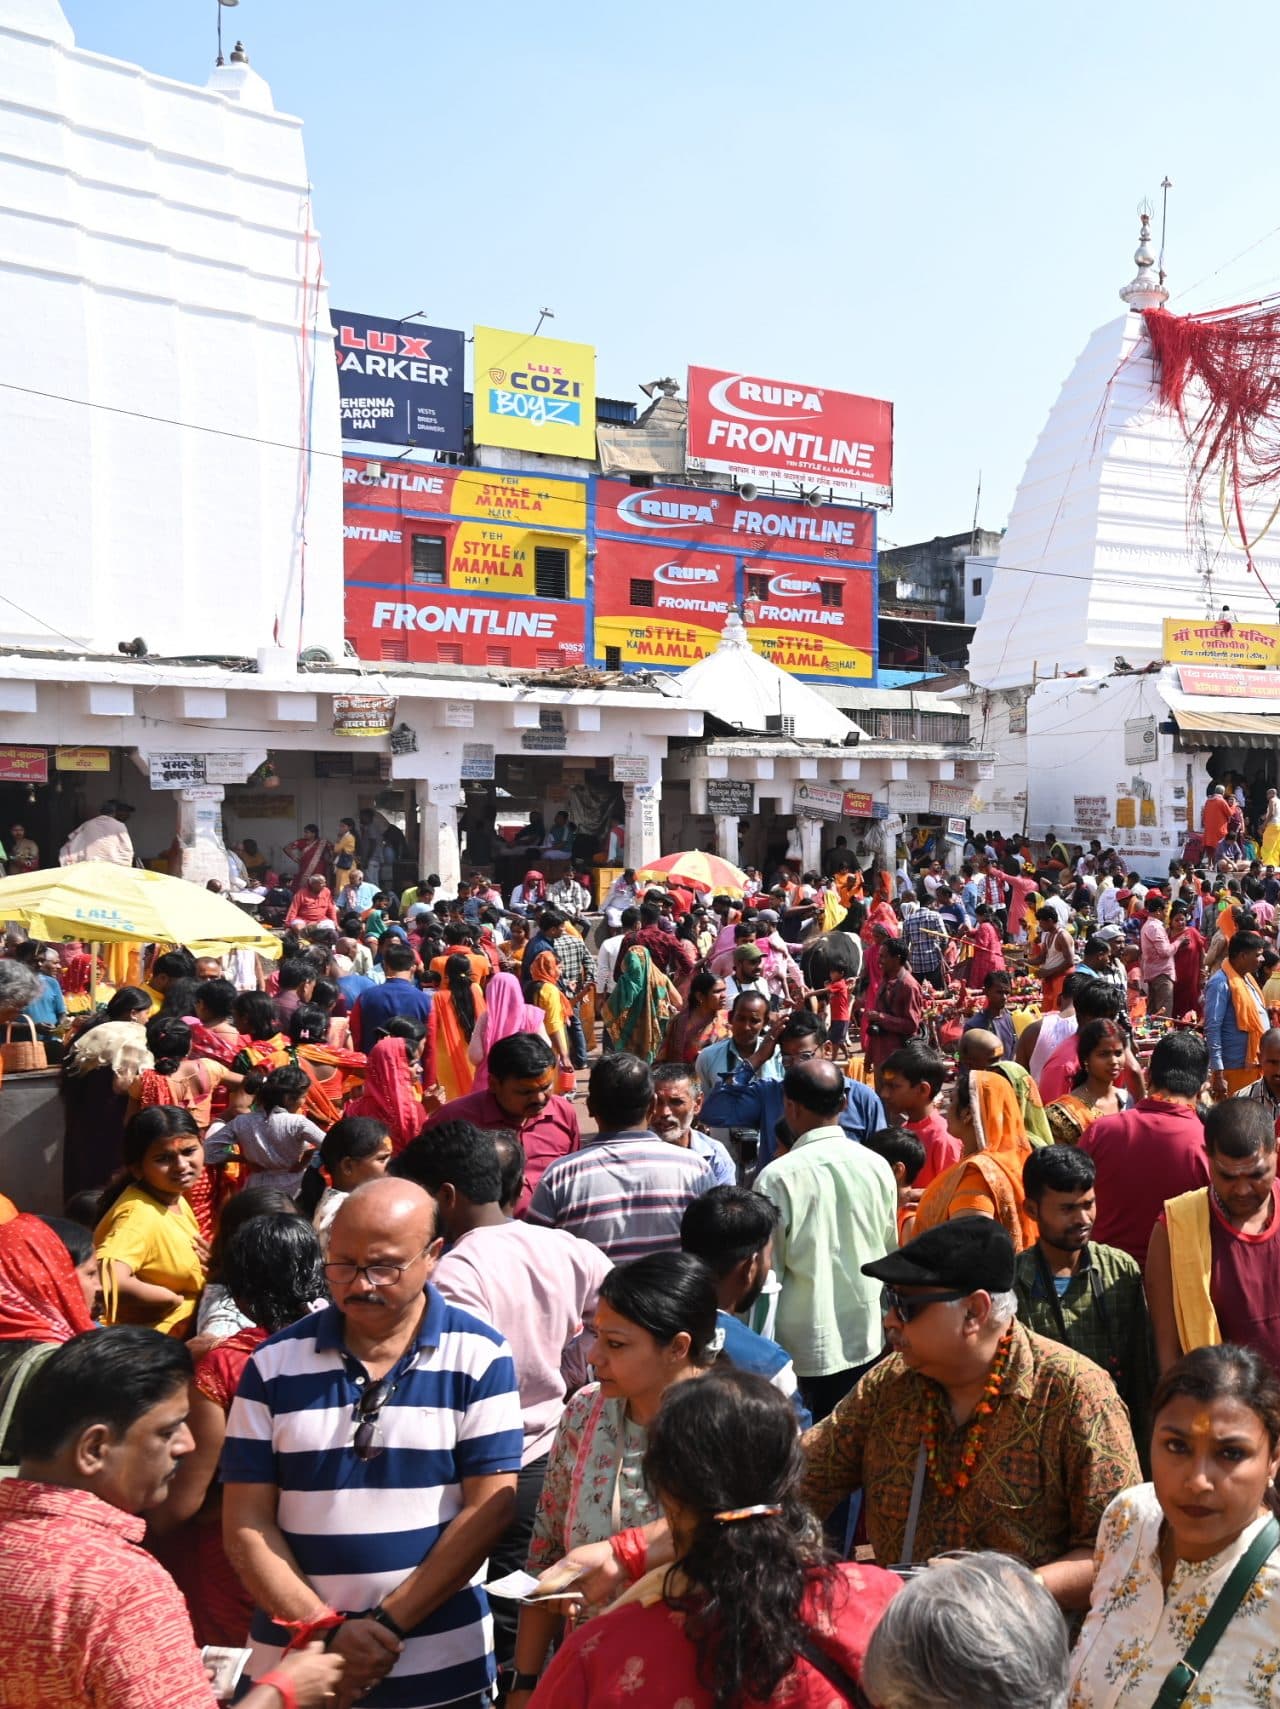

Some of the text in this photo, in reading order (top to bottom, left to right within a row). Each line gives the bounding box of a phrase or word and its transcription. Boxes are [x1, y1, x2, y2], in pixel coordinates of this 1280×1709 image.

[340, 325, 432, 360] LUX
[527, 362, 562, 375] LUX
[511, 371, 581, 397] COZI
[340, 397, 395, 408] EHENNA
[738, 381, 824, 412] RUPA
[353, 418, 376, 429] HAI
[707, 418, 875, 469] FRONTLINE
[798, 461, 821, 471] STYLE
[501, 477, 519, 485] YEH
[483, 485, 531, 498] STYLE
[475, 495, 543, 511] MAMLA
[640, 499, 714, 524] RUPA
[481, 531, 503, 540] YEH
[733, 509, 856, 545] FRONTLINE
[463, 541, 526, 560] STYLE KA
[452, 556, 524, 577] MAMLA
[668, 565, 719, 582] RUPA
[657, 596, 729, 613] FRONTLINE
[372, 601, 558, 639] FRONTLINE
[759, 605, 845, 625] FRONTLINE
[628, 626, 697, 642] YEH STYLE
[626, 640, 704, 660] KA MAMLA
[761, 636, 824, 651] YEH STYLE
[771, 651, 831, 667] MAMLA
